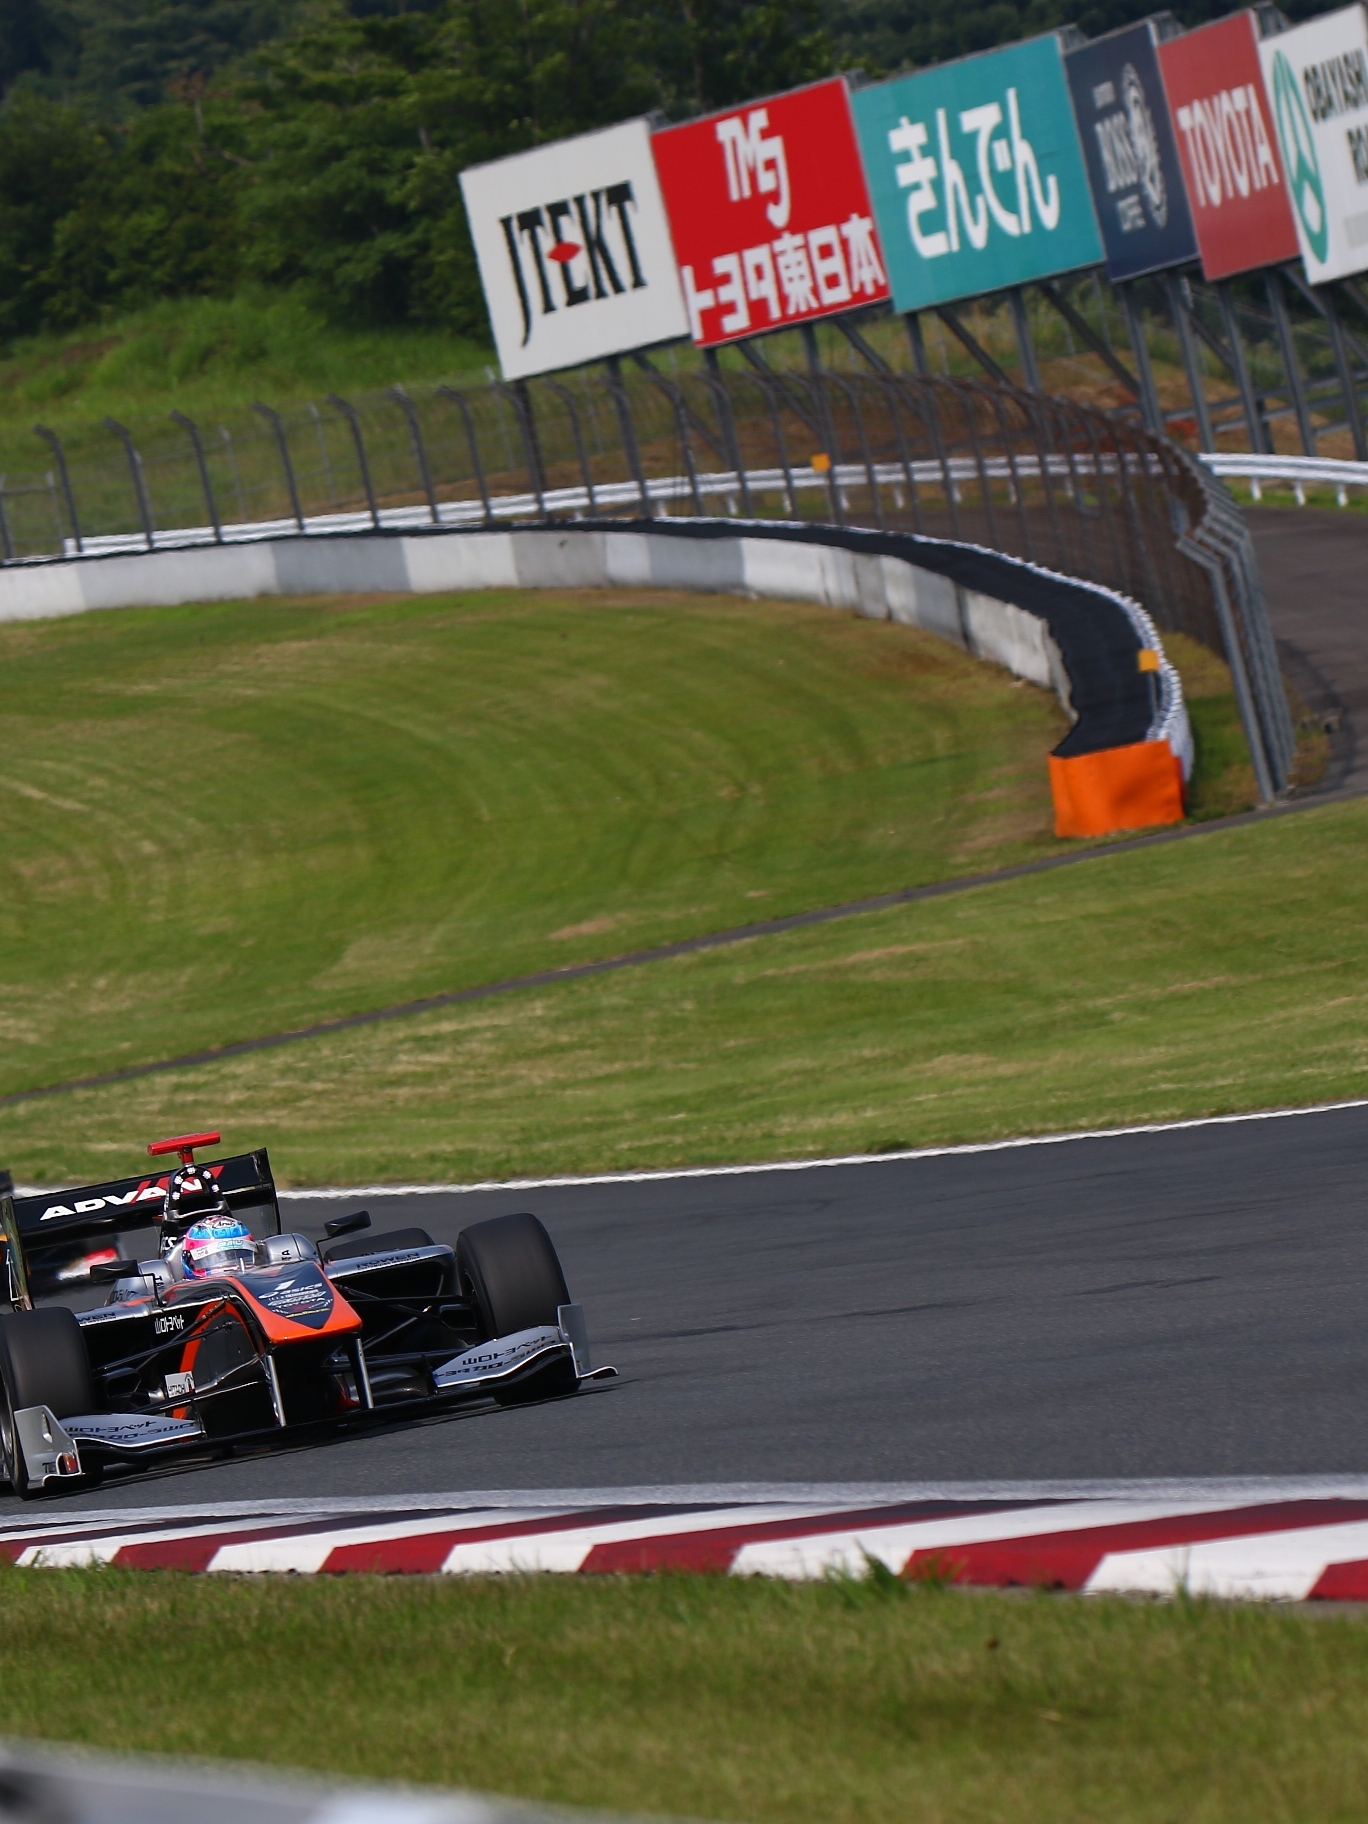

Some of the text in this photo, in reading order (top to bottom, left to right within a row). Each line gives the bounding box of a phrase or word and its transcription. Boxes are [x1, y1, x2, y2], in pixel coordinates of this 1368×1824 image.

[888, 87, 1060, 258] きんでん
[1177, 83, 1279, 208] TOYOTA
[499, 180, 648, 347] JTEKT
[682, 213, 887, 343] トヨタ東日本
[40, 1178, 203, 1221] ADVAN
[463, 1335, 553, 1366] 山口トヨペット
